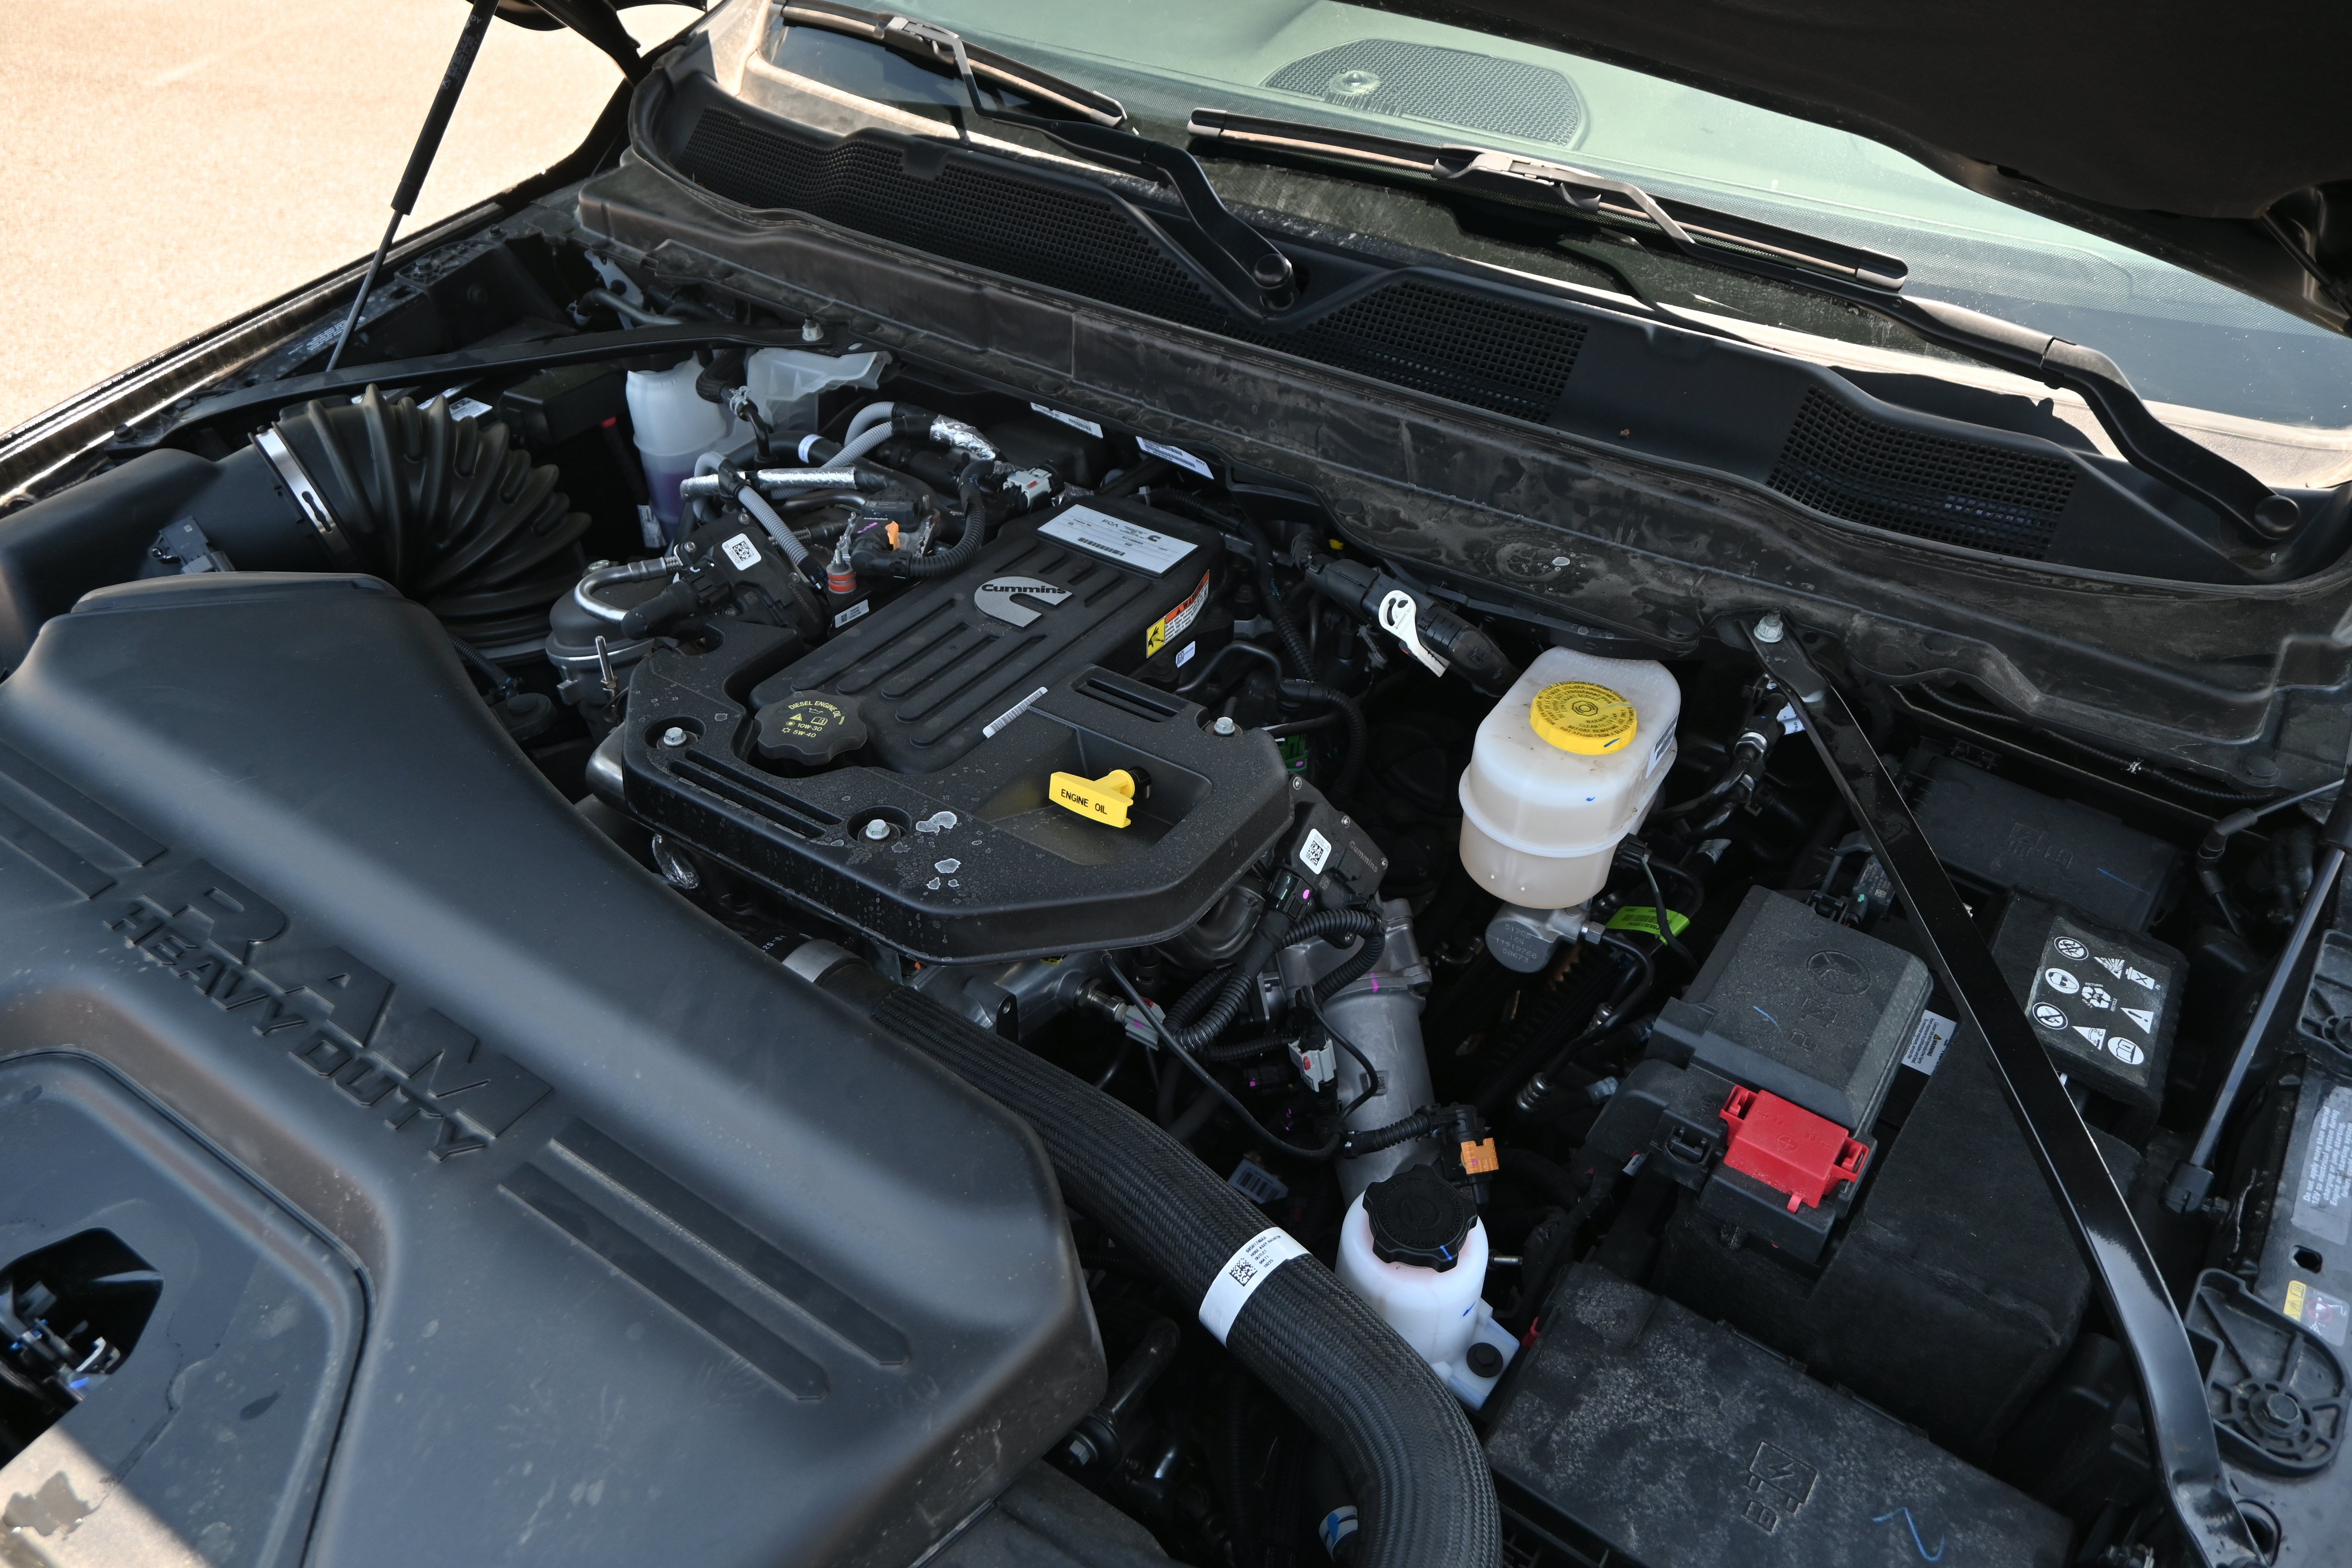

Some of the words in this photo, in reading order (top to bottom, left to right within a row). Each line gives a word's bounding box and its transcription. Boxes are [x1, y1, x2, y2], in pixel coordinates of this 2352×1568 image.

[1101, 519, 1118, 528] FCA
[981, 583, 1067, 595] Cummins
[1587, 686, 1619, 702] UNIQUEMENT
[788, 700, 813, 710] DIESEL
[814, 700, 838, 711] ENGINE
[1586, 714, 1609, 723] WARNING
[792, 730, 817, 738] 5W-40
[797, 723, 822, 731] 10W-30
[1592, 724, 1619, 732] REMOVING
[1614, 724, 1630, 734] SEALED
[1061, 788, 1089, 808] ENGINE
[1094, 803, 1108, 816] OIL
[1350, 840, 1378, 872] Cummins
[142, 859, 552, 1138] RAM
[2082, 998, 2093, 1008] LEAD
[102, 895, 307, 1037] HEAVY
[288, 1029, 488, 1162] DUTY
[1927, 1040, 1938, 1056] WARNING
[2320, 1106, 2330, 1130] nominal
[2328, 1109, 2340, 1129] during
[2316, 1130, 2325, 1145] than
[2325, 1130, 2334, 1152] system
[2314, 1145, 2322, 1161] more
[2329, 1149, 2340, 1165] jump
[2310, 1162, 2320, 1179] apply
[2318, 1152, 2329, 1182] electrical
[2329, 1164, 2335, 1172] or
[2330, 1184, 2341, 1206] Engine
[2338, 1145, 2350, 1171] starting
[1429, 1178, 1448, 1192] USE
[2316, 1182, 2323, 1190] to
[2322, 1173, 2335, 1201] charging
[2303, 1192, 2311, 1201] Do
[2311, 1190, 2321, 1204] 12V
[1378, 1195, 1402, 1240] STEERING
[1445, 1195, 1462, 1240] APPROVED
[1250, 1248, 1259, 1257] HOSE
[1255, 1250, 1267, 1260] OUTLET
